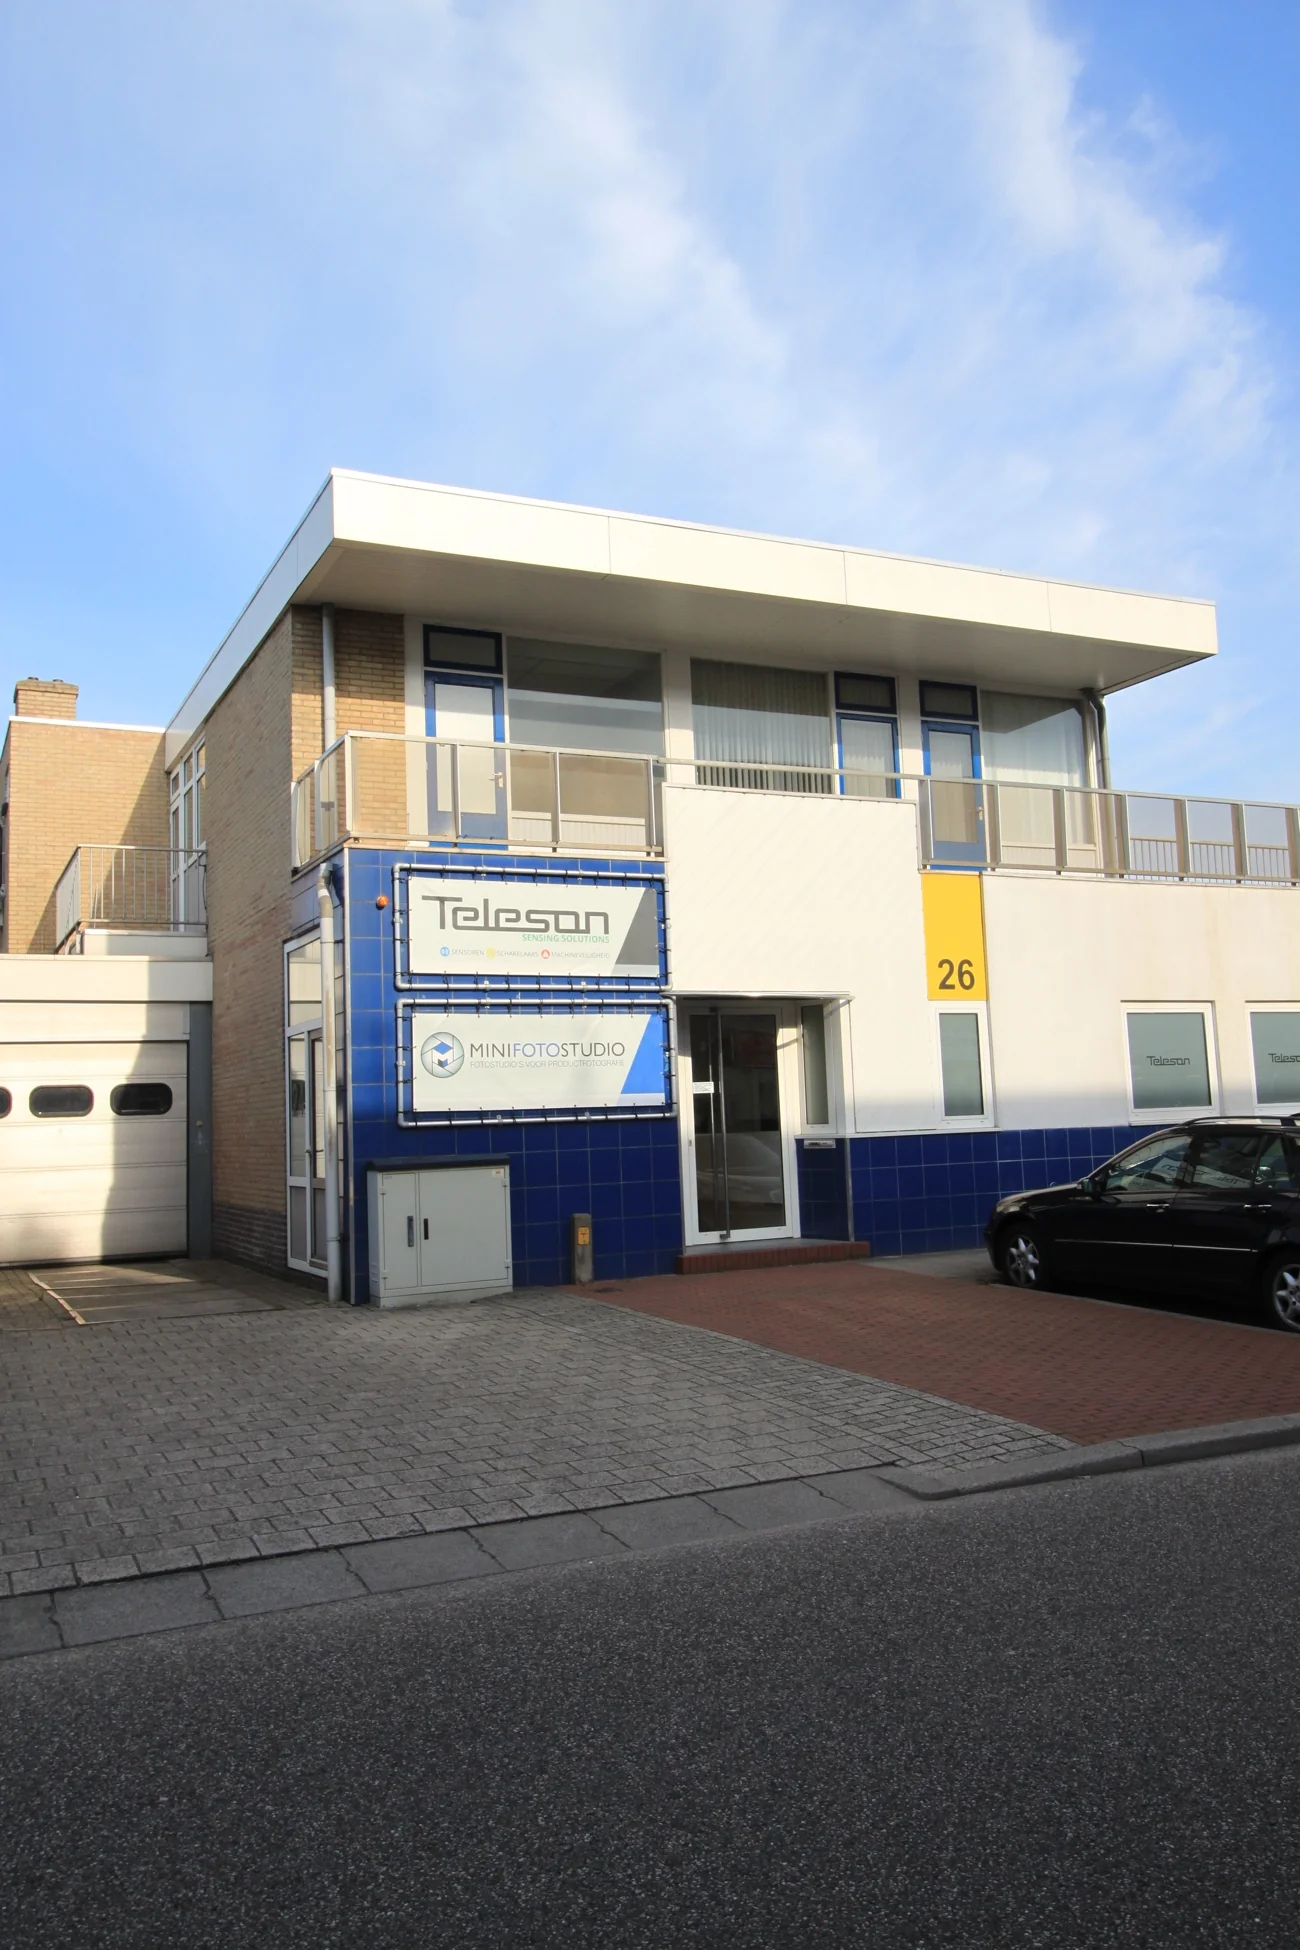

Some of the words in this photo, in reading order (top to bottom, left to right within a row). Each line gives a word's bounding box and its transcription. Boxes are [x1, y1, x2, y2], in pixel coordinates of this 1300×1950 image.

[422, 895, 609, 934] Teleson
[522, 933, 559, 943] SENSING
[561, 935, 609, 944] SOLUTIONS
[451, 948, 484, 956] SENSOREN
[938, 959, 975, 990] 26
[470, 1042, 625, 1058] MINIFOTOSTUDIO
[470, 1060, 524, 1069] FOTOSTUDIO'S
[525, 1060, 546, 1068] VOOR
[1146, 1055, 1190, 1066] Teleson
